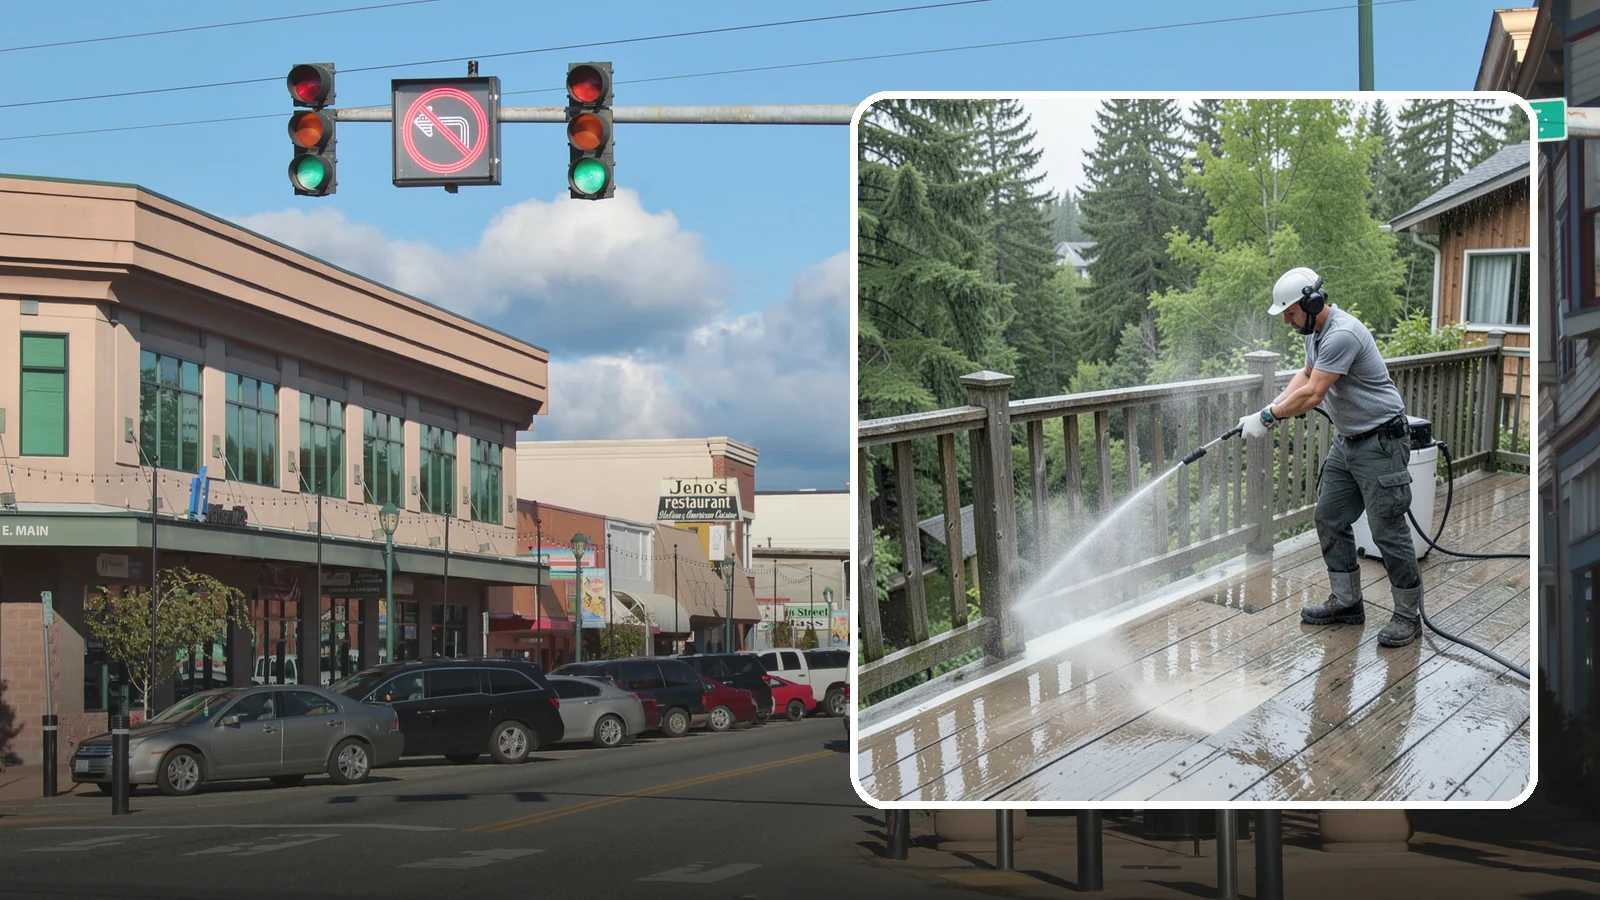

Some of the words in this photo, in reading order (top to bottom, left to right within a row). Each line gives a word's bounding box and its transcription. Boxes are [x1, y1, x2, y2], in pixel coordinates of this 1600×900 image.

[669, 480, 728, 494] Jeno's
[665, 496, 731, 509] restaurant
[658, 510, 682, 520] Italian
[686, 510, 715, 519] American
[715, 509, 738, 519] Cuisine
[2, 525, 13, 536] E.
[15, 525, 49, 536] MAIN
[797, 607, 829, 617] Street
